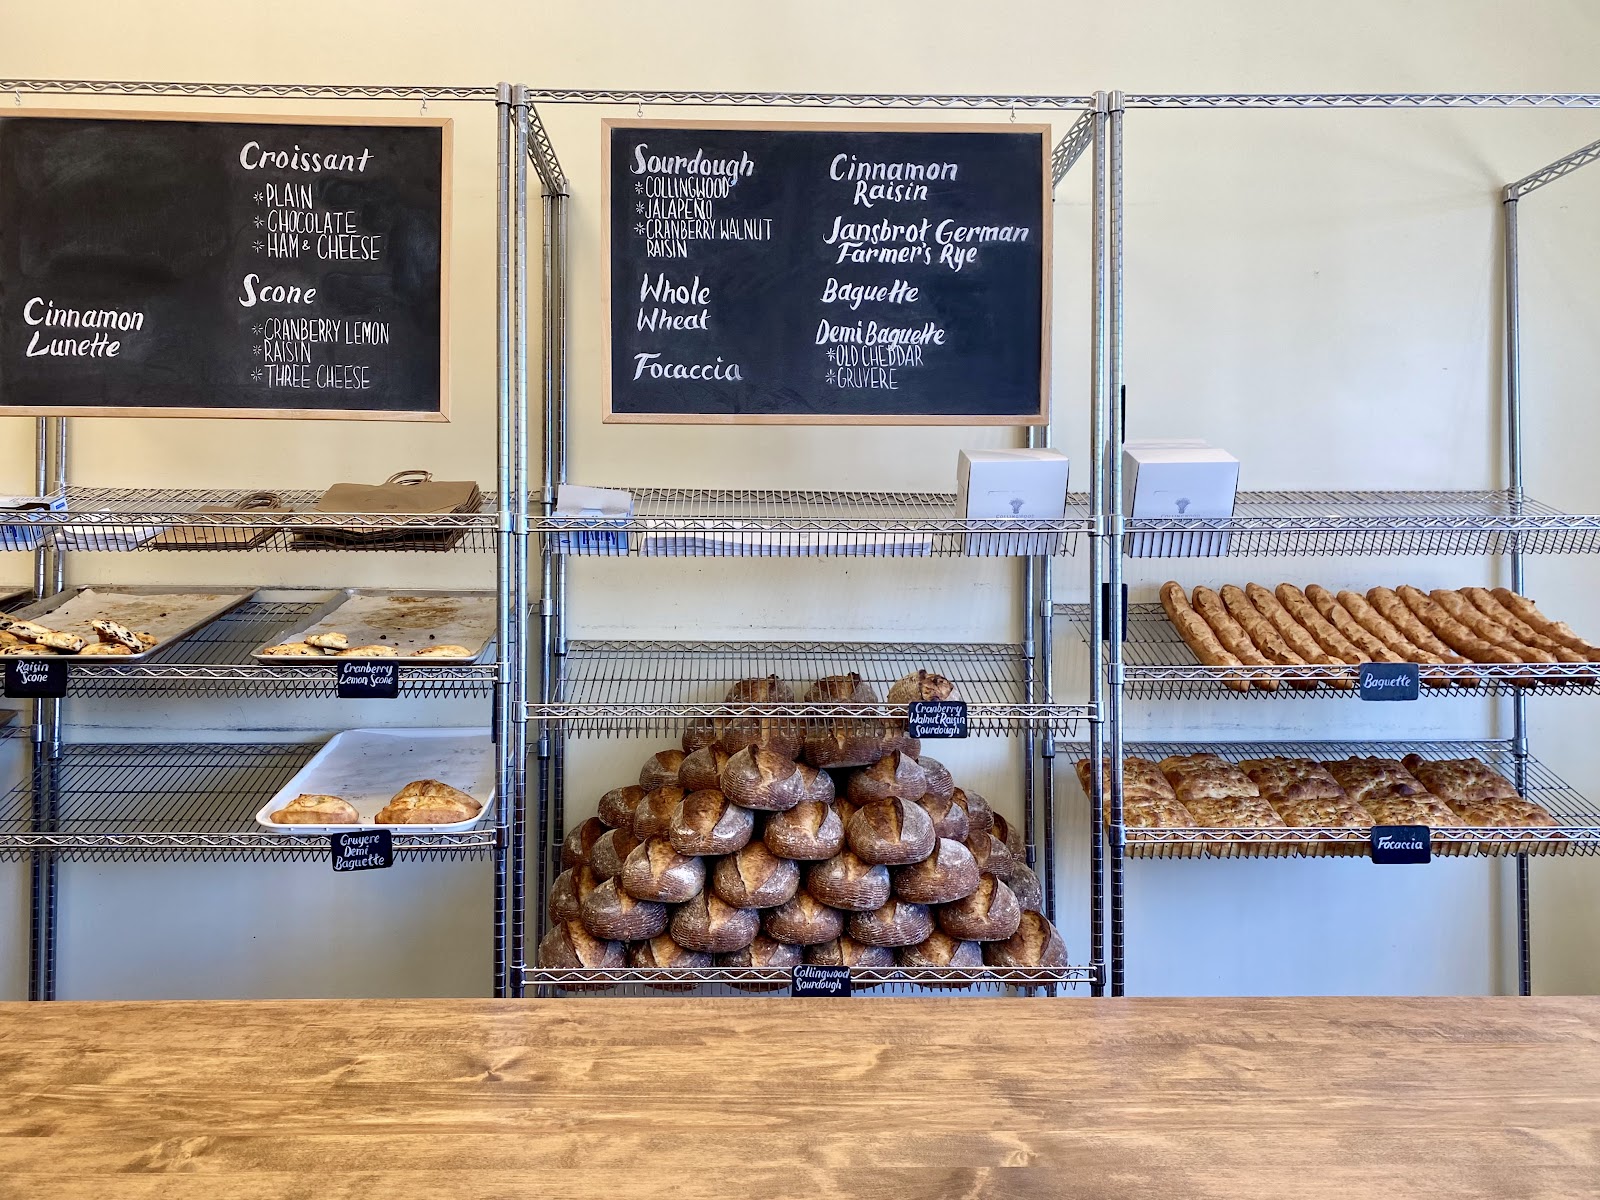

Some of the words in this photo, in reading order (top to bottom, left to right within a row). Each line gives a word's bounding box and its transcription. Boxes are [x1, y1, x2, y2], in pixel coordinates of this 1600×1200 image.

[239, 141, 374, 172] Croissant
[630, 143, 755, 187] Sourdough
[829, 153, 958, 181] Cinnamon
[266, 183, 313, 209] PLAIN
[645, 176, 729, 198] COLLINGWOOD
[853, 180, 928, 208] Raisin
[267, 209, 357, 233] CHOCOLATE
[646, 219, 716, 240] CRANBERRY
[720, 218, 773, 241] WALNUT
[823, 215, 932, 244] Jansbrot
[935, 218, 1030, 245] German
[267, 233, 299, 258] HAM
[302, 240, 310, 250] &
[317, 234, 381, 260] CHEESE
[646, 239, 687, 258] RAISIN
[836, 242, 931, 265] Farmer's
[939, 243, 978, 272] Rye
[238, 273, 317, 307] Scone
[640, 273, 711, 305] Whole
[820, 277, 919, 310] Baguette
[23, 297, 144, 331] Cinnamon
[637, 308, 711, 332] Wheat
[26, 330, 121, 357] Lunette
[264, 318, 341, 342] CRANBERRY
[345, 321, 389, 345] LEMON
[815, 319, 863, 345] Demi
[865, 321, 946, 351] Baguette
[264, 339, 311, 363] RAISIN
[836, 345, 859, 367] OLD
[861, 345, 924, 367] CHEDDAR
[264, 364, 311, 388] THREE
[316, 365, 370, 389] CHEESE
[633, 352, 743, 381] Focaccia
[837, 367, 899, 389] GRUYERE
[16, 660, 49, 673] Raisin
[21, 671, 48, 684] Scone
[344, 662, 394, 677] Cranberry
[339, 674, 368, 685] Lemon
[370, 674, 394, 688] Scone
[1363, 673, 1412, 690] Baguette
[909, 712, 940, 725] Walnut
[940, 712, 966, 727] Raisin
[915, 702, 962, 716] Cranberry
[915, 725, 960, 738] Sourdough
[340, 834, 380, 848] Gruyere
[344, 845, 369, 858] Demi
[1377, 835, 1424, 850] Focaccia
[334, 853, 385, 871] Baguette
[793, 965, 850, 981] Collingwood
[796, 977, 842, 993] Sourdough
